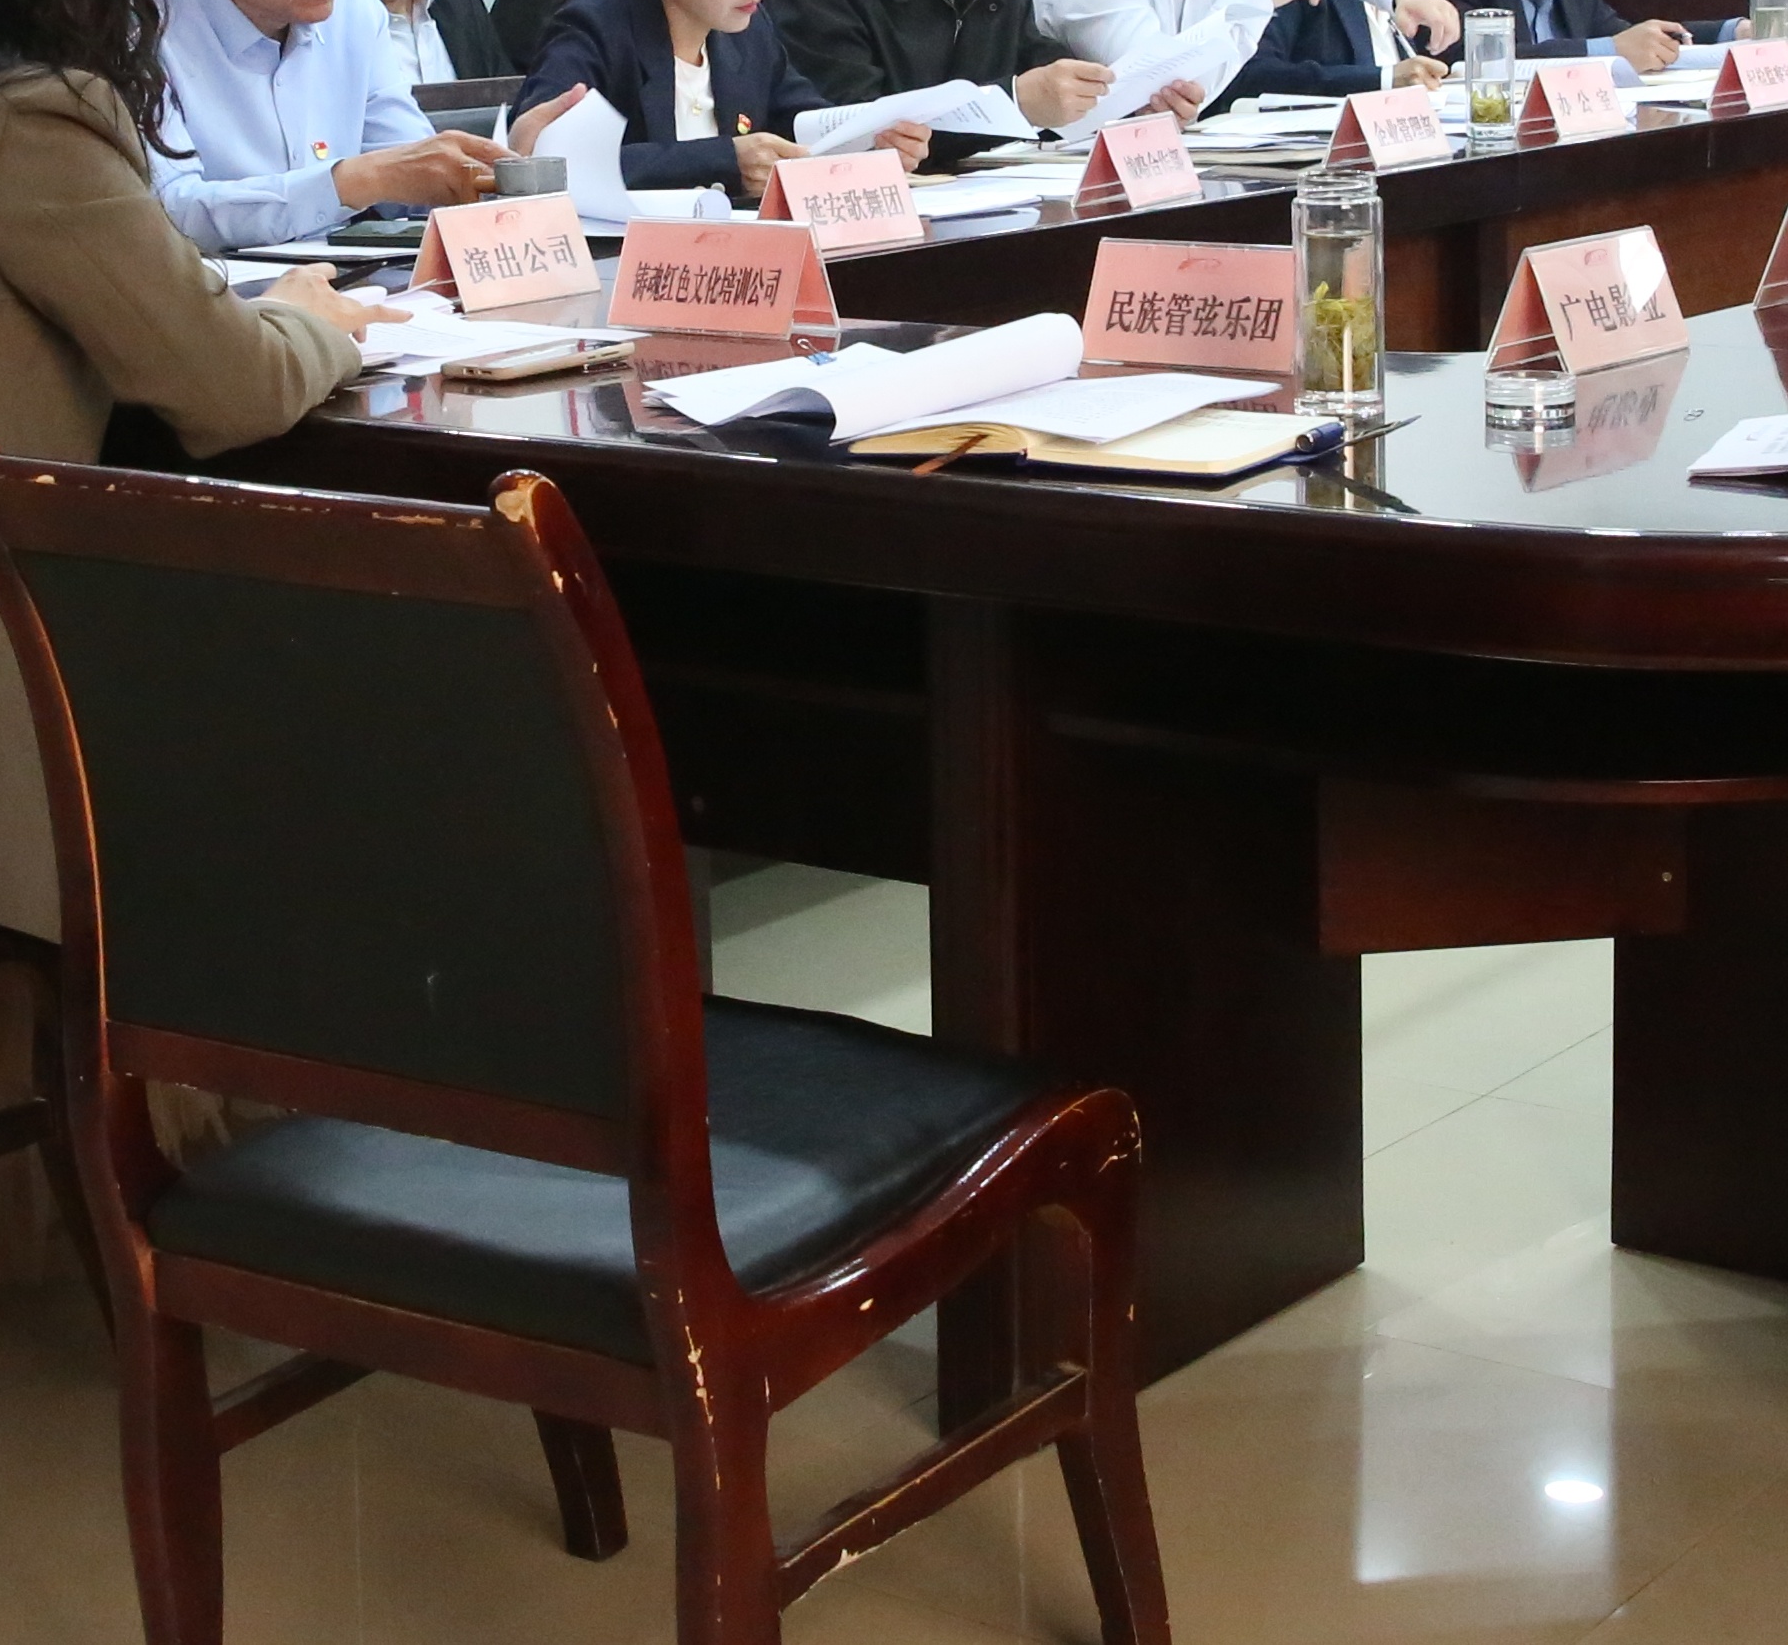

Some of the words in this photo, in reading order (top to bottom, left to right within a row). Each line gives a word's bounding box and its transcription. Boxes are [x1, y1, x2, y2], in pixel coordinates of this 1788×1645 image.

[1557, 88, 1616, 117] 办公室
[1373, 114, 1436, 146] 企业管理部
[803, 183, 906, 229] 延安歌舞团
[464, 233, 579, 285] 演出公司
[633, 260, 784, 308] 铸魂红色文化培训公司
[1106, 290, 1283, 342] 民族管弦乐团
